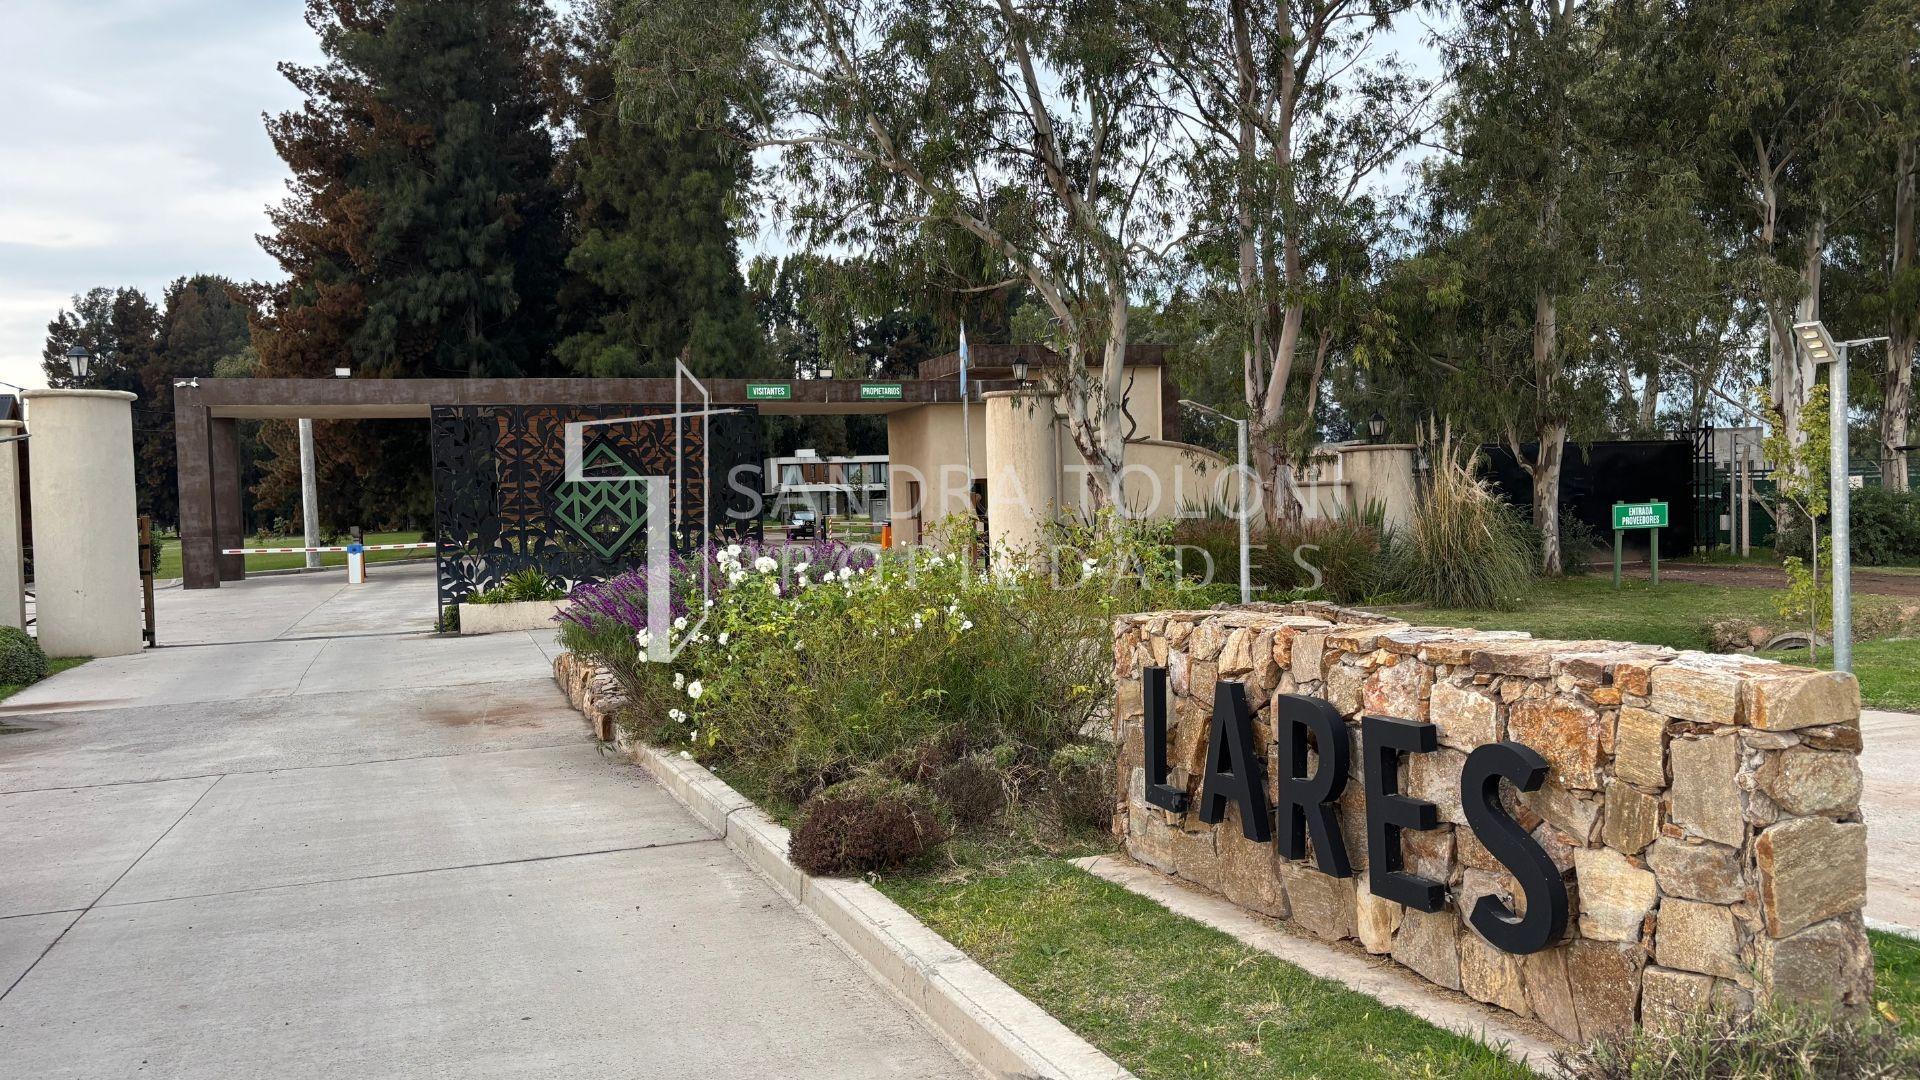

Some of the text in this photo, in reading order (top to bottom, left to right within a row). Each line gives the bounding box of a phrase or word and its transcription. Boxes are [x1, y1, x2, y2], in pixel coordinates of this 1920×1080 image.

[752, 387, 785, 396] VISITANTES
[862, 387, 900, 395] PROPIETARIOS
[1628, 506, 1653, 516] ENTRADA
[1621, 515, 1660, 525] PROVEEDORES
[1143, 666, 1569, 955] LARES
